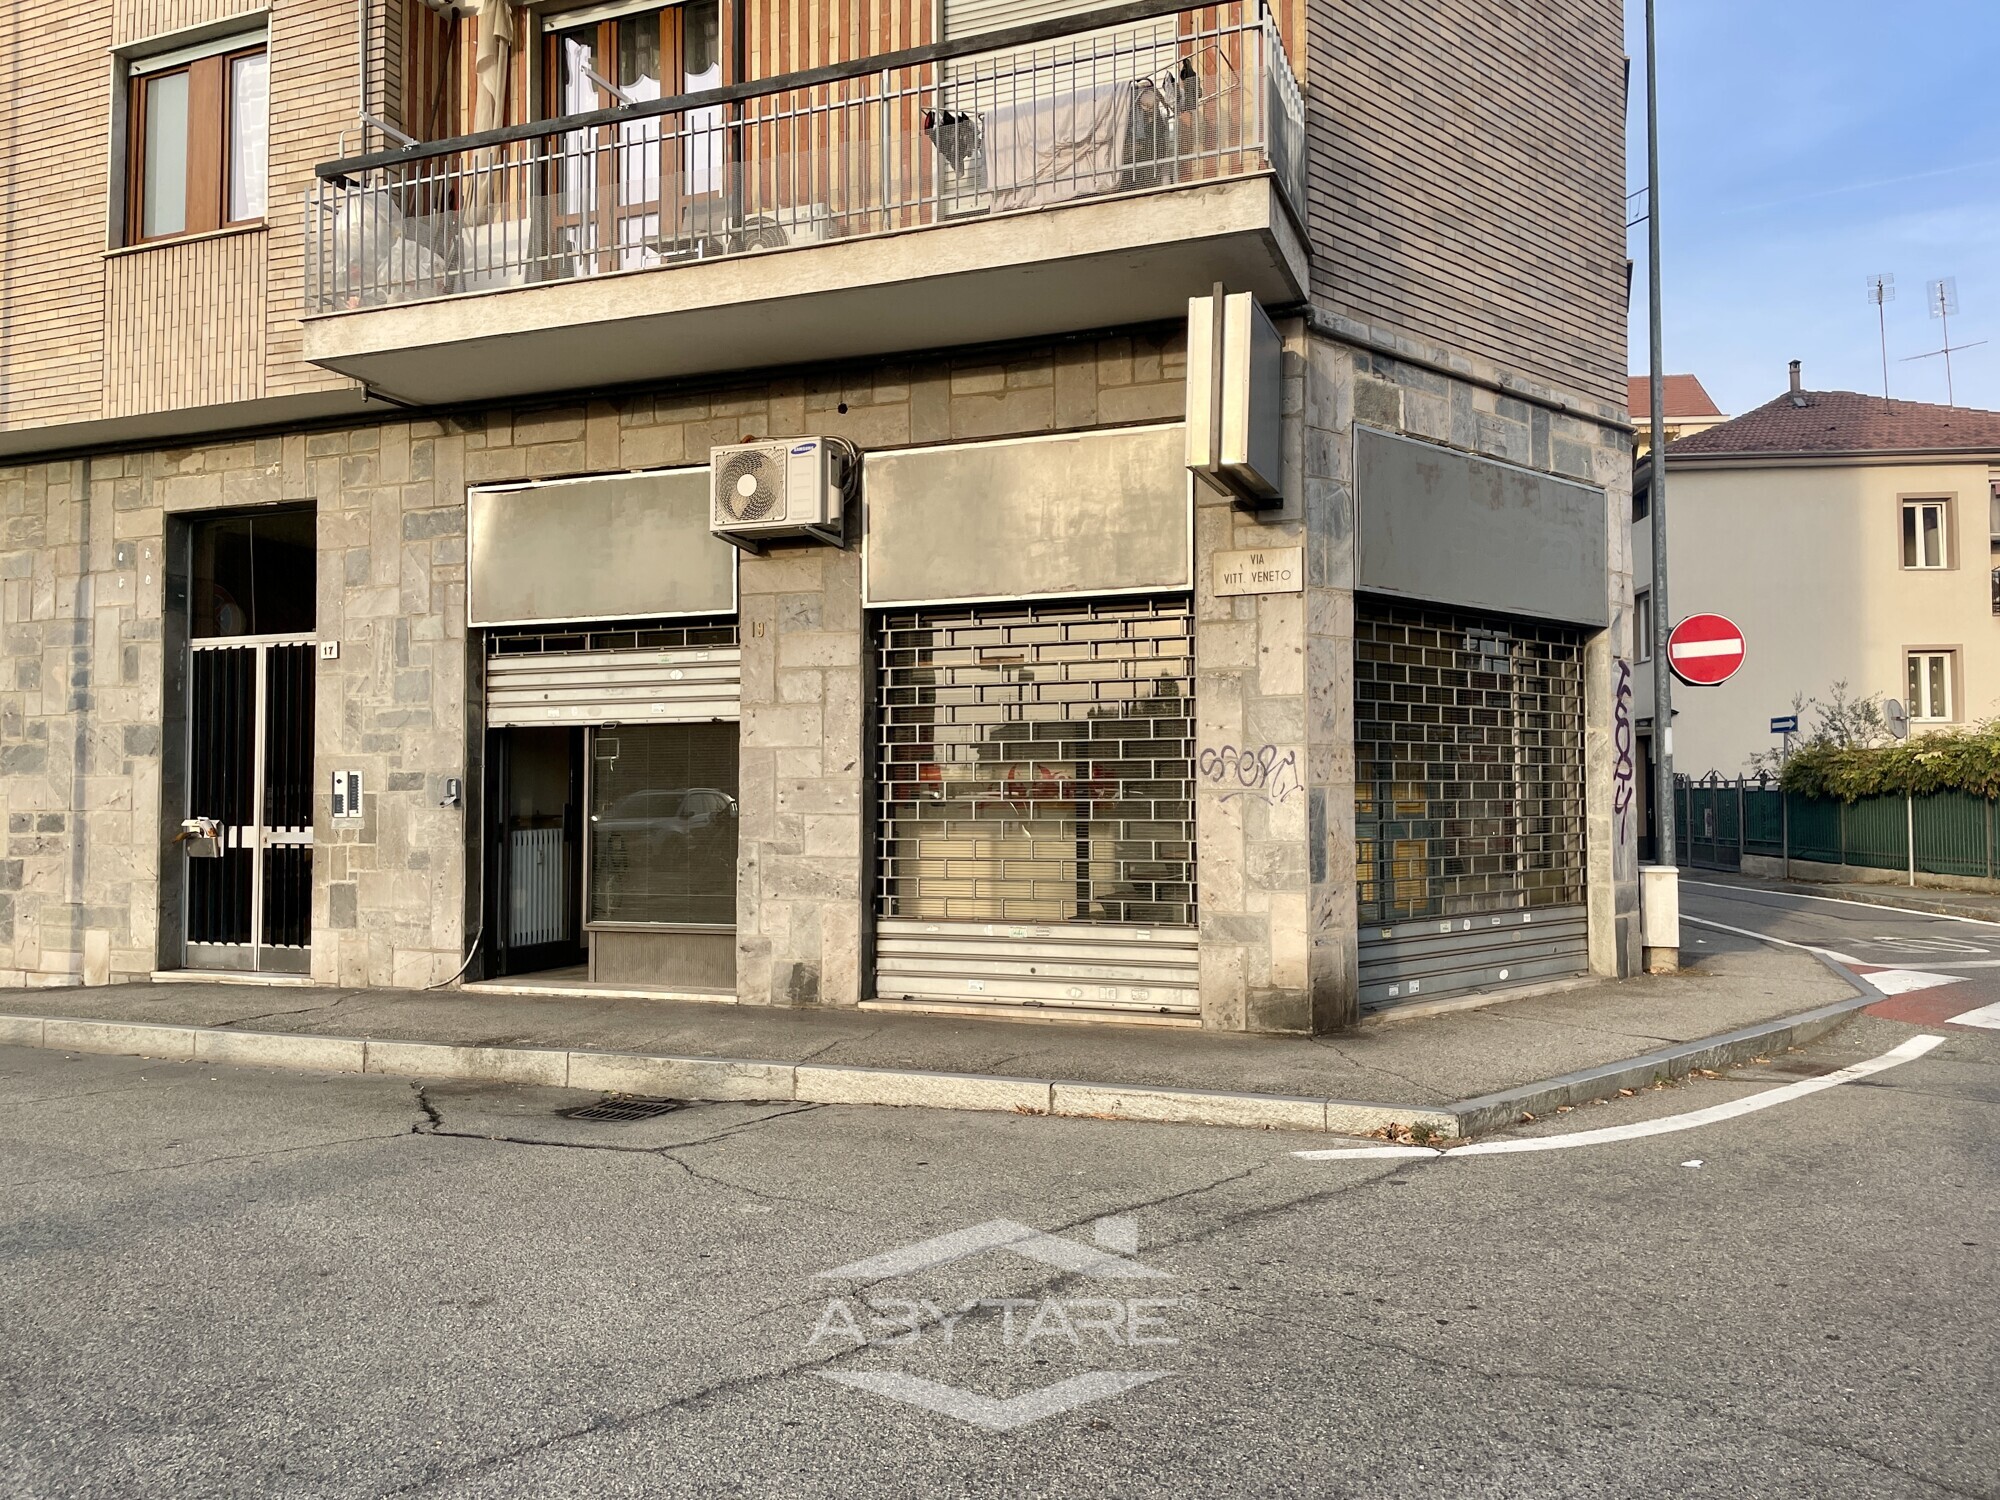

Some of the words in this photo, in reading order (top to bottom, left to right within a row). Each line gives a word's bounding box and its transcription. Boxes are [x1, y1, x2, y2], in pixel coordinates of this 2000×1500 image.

[1250, 554, 1265, 565] VIA
[1251, 569, 1291, 583] VENETO
[322, 646, 334, 656] 17
